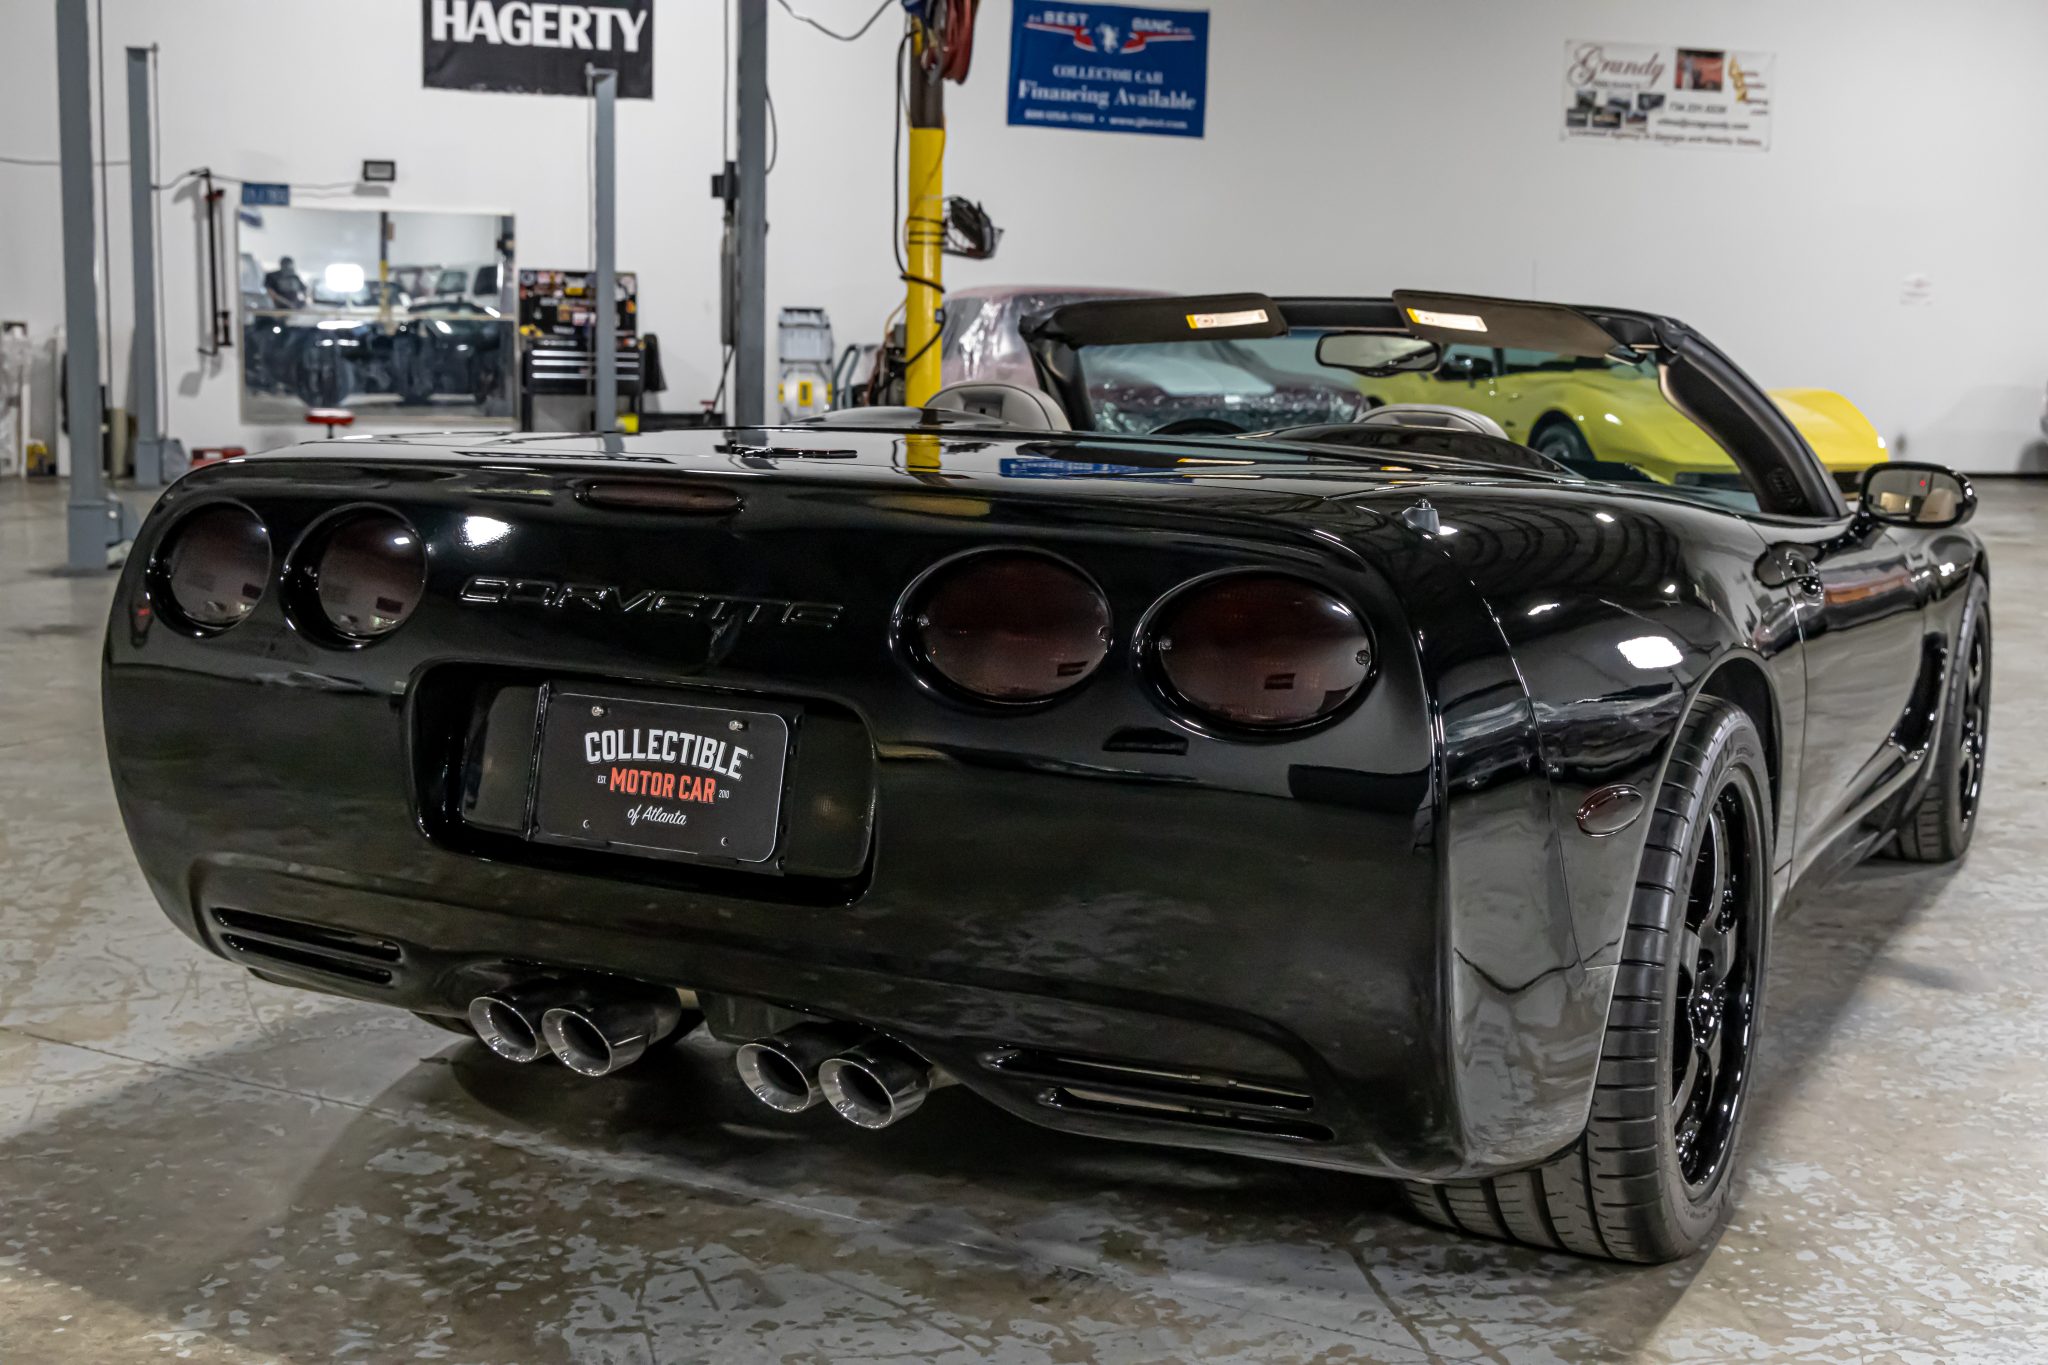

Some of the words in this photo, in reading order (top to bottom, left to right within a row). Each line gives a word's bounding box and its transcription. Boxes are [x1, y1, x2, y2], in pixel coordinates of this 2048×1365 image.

[431, 0, 648, 52] HAGERTY
[1044, 11, 1089, 26] BEST
[1052, 64, 1132, 82] COLLECTOR
[1134, 70, 1164, 85] CAR
[1018, 79, 1110, 110] Financing
[1114, 87, 1197, 111] Available
[460, 575, 844, 628] CORVETTE
[584, 728, 749, 781] COLLECTIBLE
[609, 767, 675, 799] MOTOR
[678, 774, 717, 804] CAR
[718, 789, 730, 799] 2010
[627, 804, 642, 826] of
[642, 805, 687, 826] Atlanta
